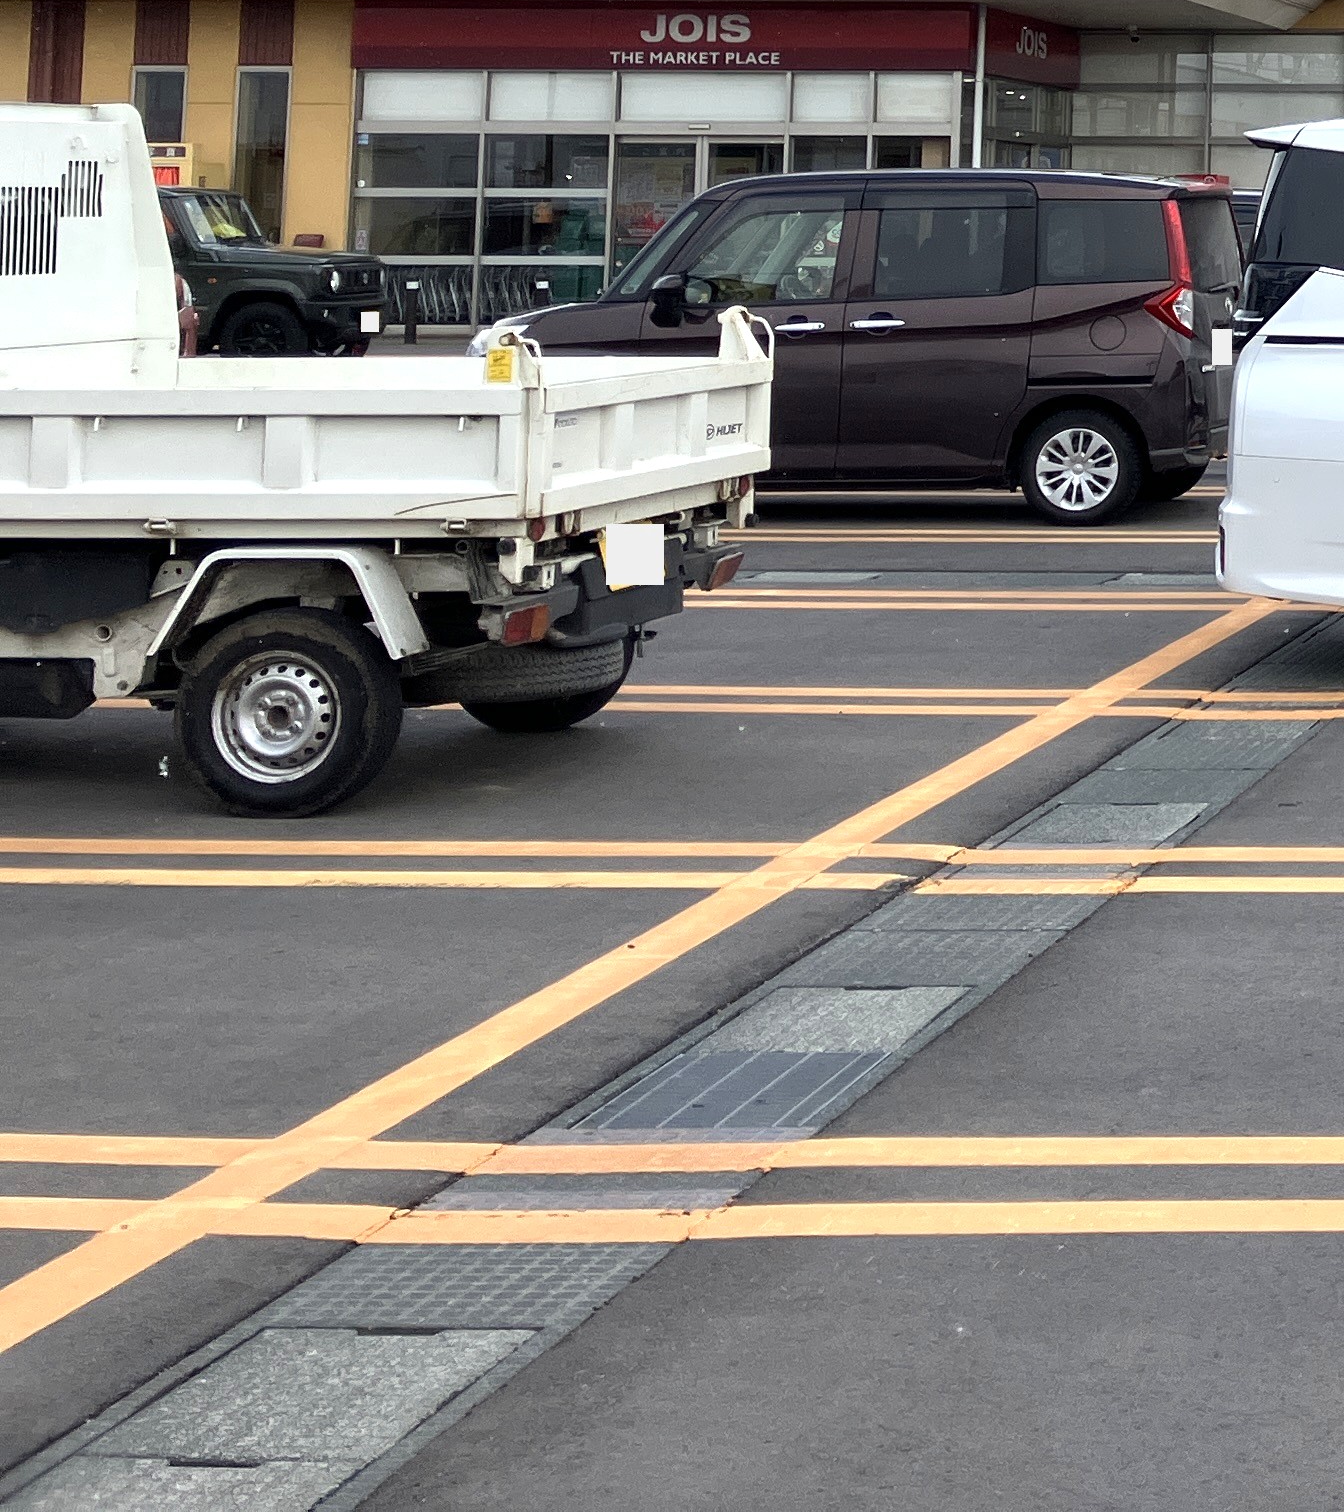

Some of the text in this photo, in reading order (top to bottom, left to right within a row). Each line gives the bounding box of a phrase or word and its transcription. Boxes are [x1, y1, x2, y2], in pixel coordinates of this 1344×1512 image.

[640, 13, 751, 43] JOIS
[1016, 28, 1047, 59] JOIS
[610, 51, 780, 65] THE MARKET PLACE
[716, 423, 743, 436] HIJET
